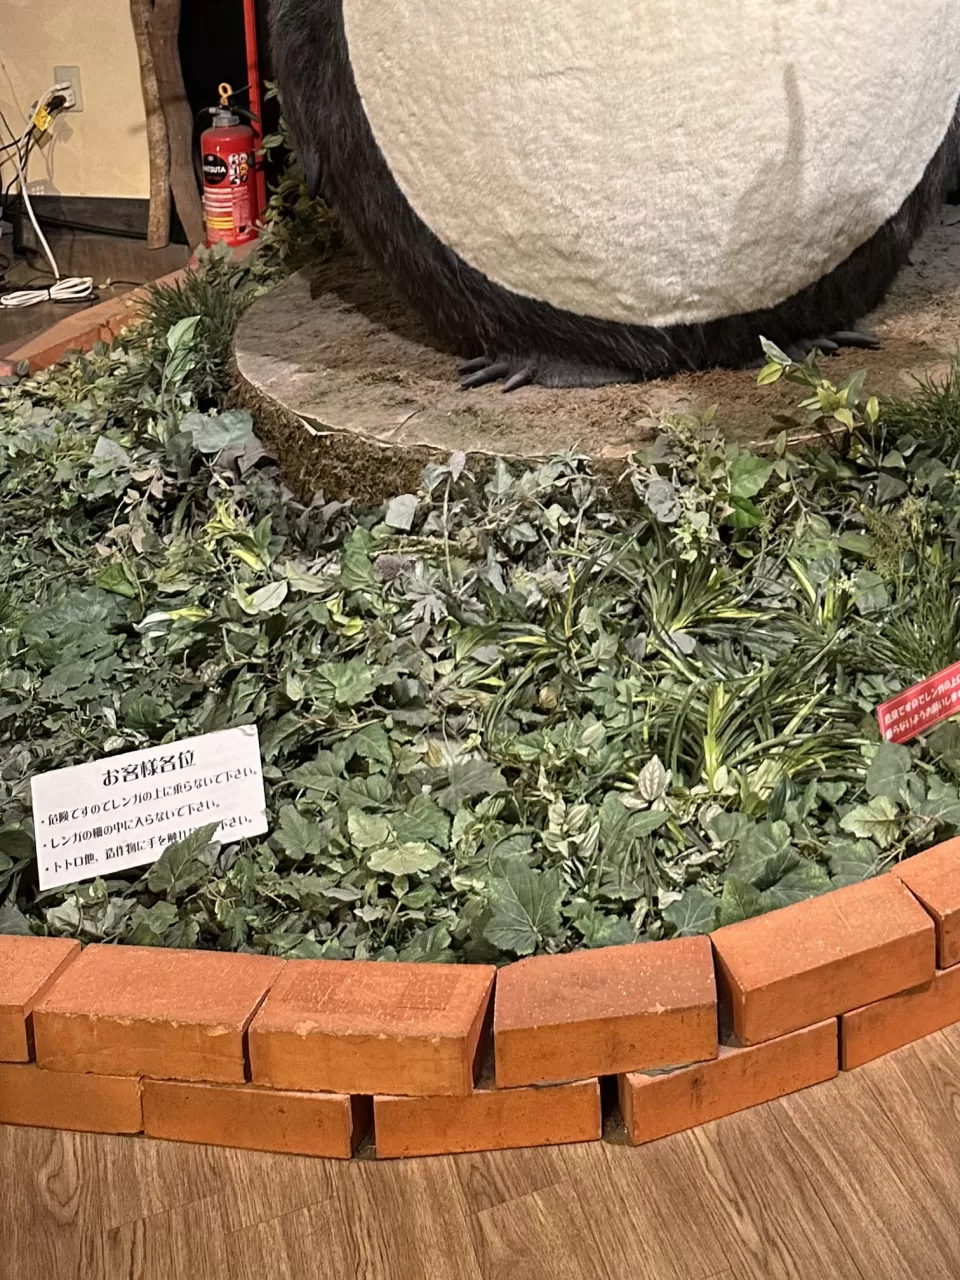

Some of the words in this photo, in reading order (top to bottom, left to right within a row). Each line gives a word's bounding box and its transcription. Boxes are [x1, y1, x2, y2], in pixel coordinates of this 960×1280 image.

[102, 748, 197, 788] お客様各位
